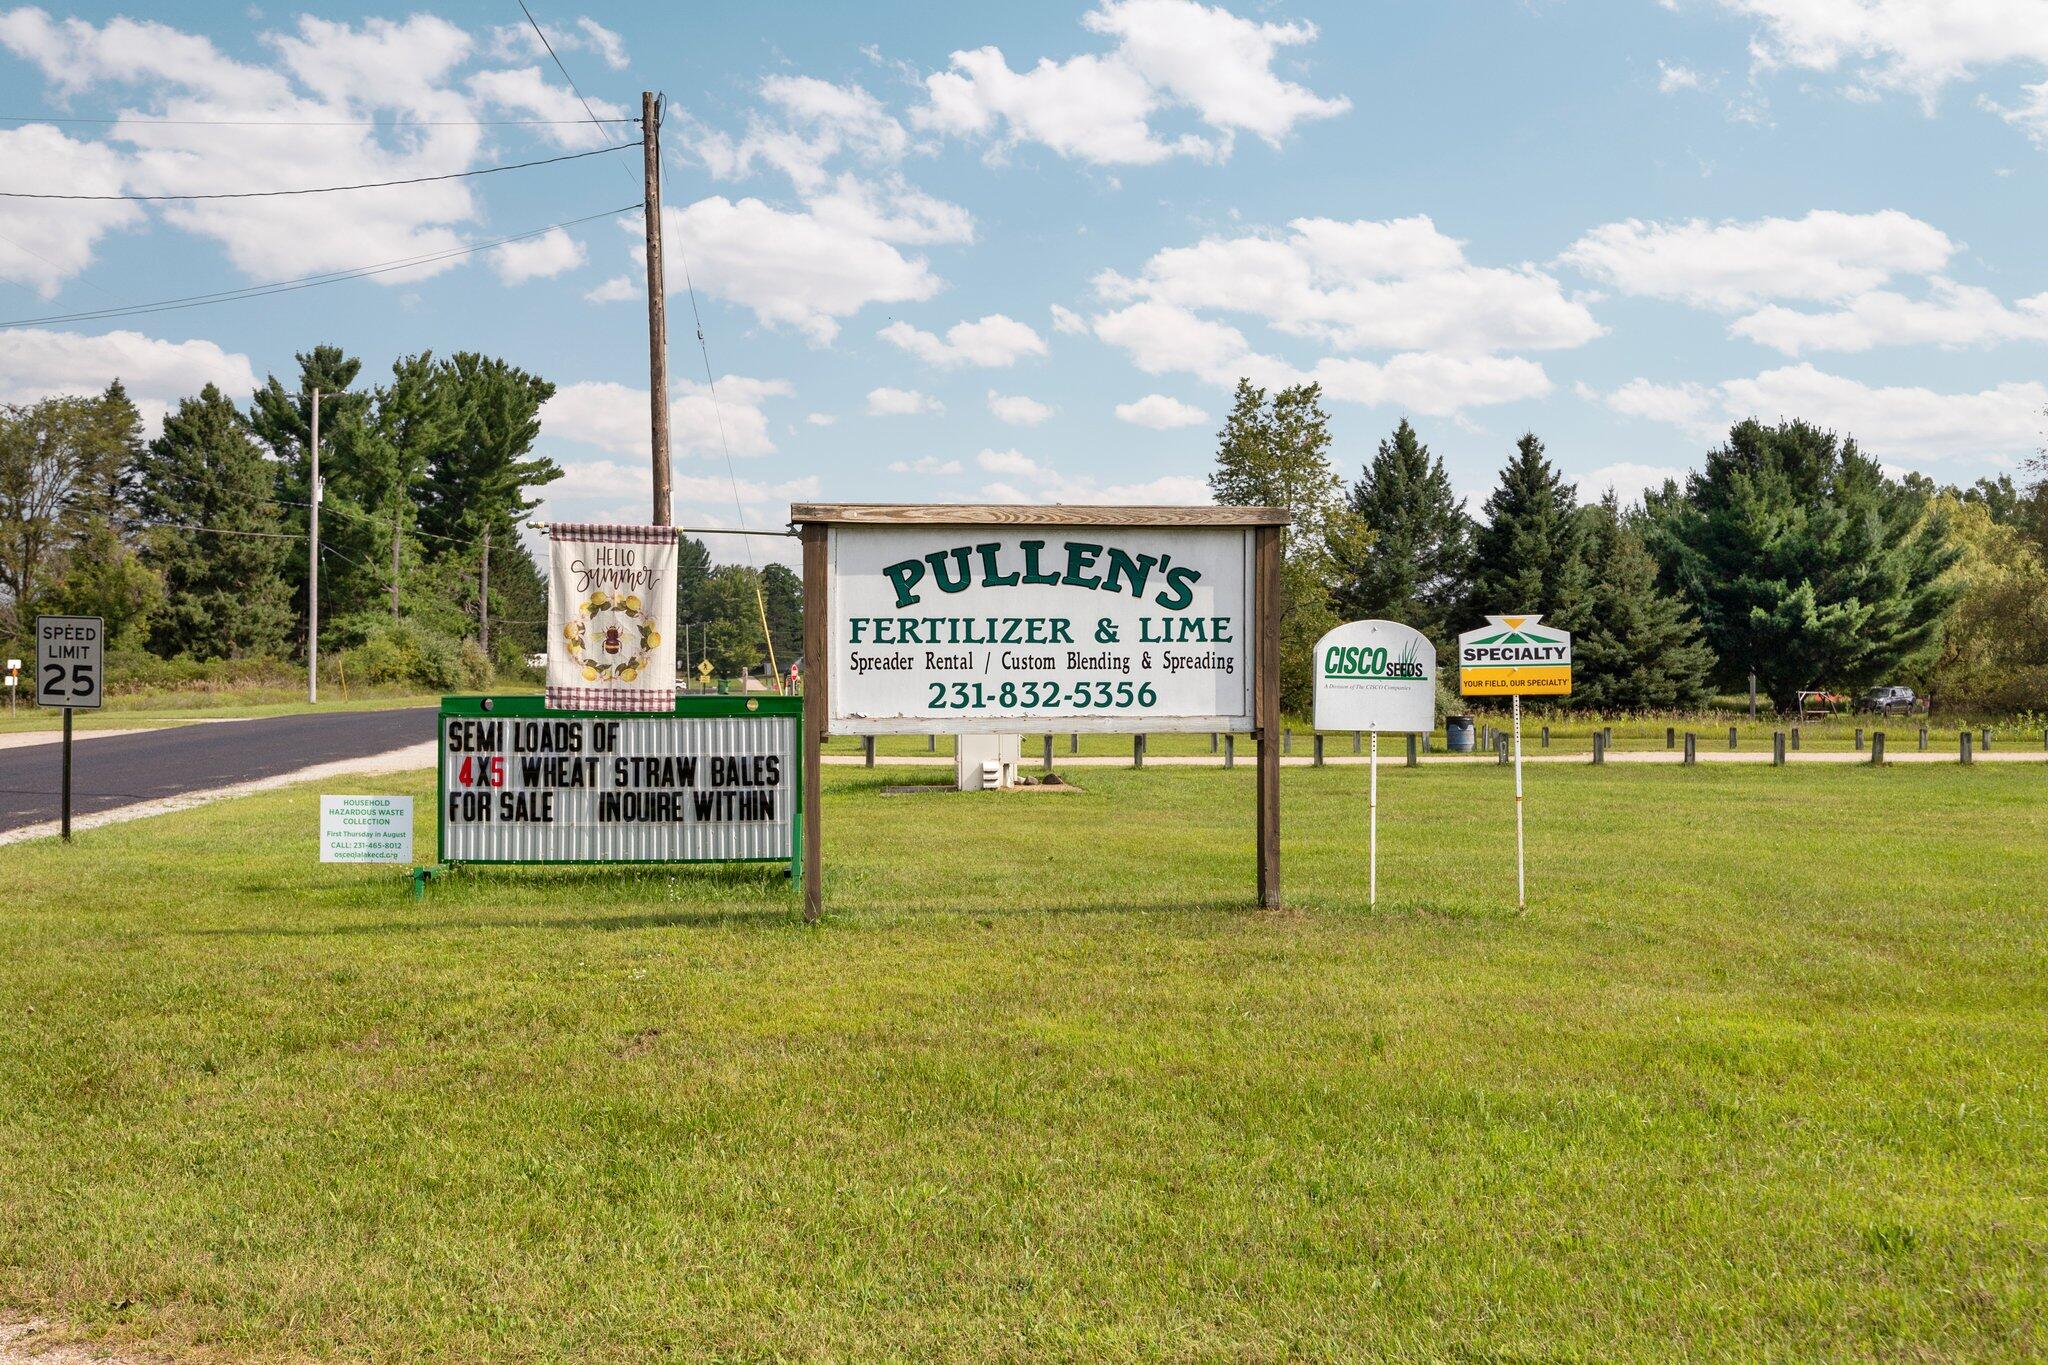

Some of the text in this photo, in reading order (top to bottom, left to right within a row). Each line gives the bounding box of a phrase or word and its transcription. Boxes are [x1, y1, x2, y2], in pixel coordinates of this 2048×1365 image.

[597, 547, 636, 566] HELLO
[571, 560, 660, 593] Summer
[883, 540, 1201, 610] PULLEN'S
[43, 626, 96, 641] SPEED
[849, 616, 1233, 644] FERTILIZER & LIME
[49, 645, 90, 659] LIMIT
[850, 651, 914, 674] Spreader
[926, 651, 973, 670] Rental
[1001, 651, 1056, 670] Custom
[1067, 651, 1130, 674] Blending
[1141, 652, 1152, 669] &
[1163, 651, 1234, 674] Spreading
[1325, 646, 1423, 677] CISCO SEEDS
[1464, 647, 1566, 661] SPECIALTY
[43, 664, 95, 697] 25
[928, 681, 1157, 708] 231-832-5356
[1464, 680, 1483, 688] YOUR
[1485, 680, 1508, 688] FIELD,
[1528, 679, 1567, 687] SPECIALTY
[449, 721, 620, 752] SEMI LOADS OF
[459, 755, 780, 788] 4X5 WHEAT STRAW BALES
[449, 791, 491, 822] FOR
[500, 791, 554, 822] SALE
[694, 789, 775, 822] WITHIN
